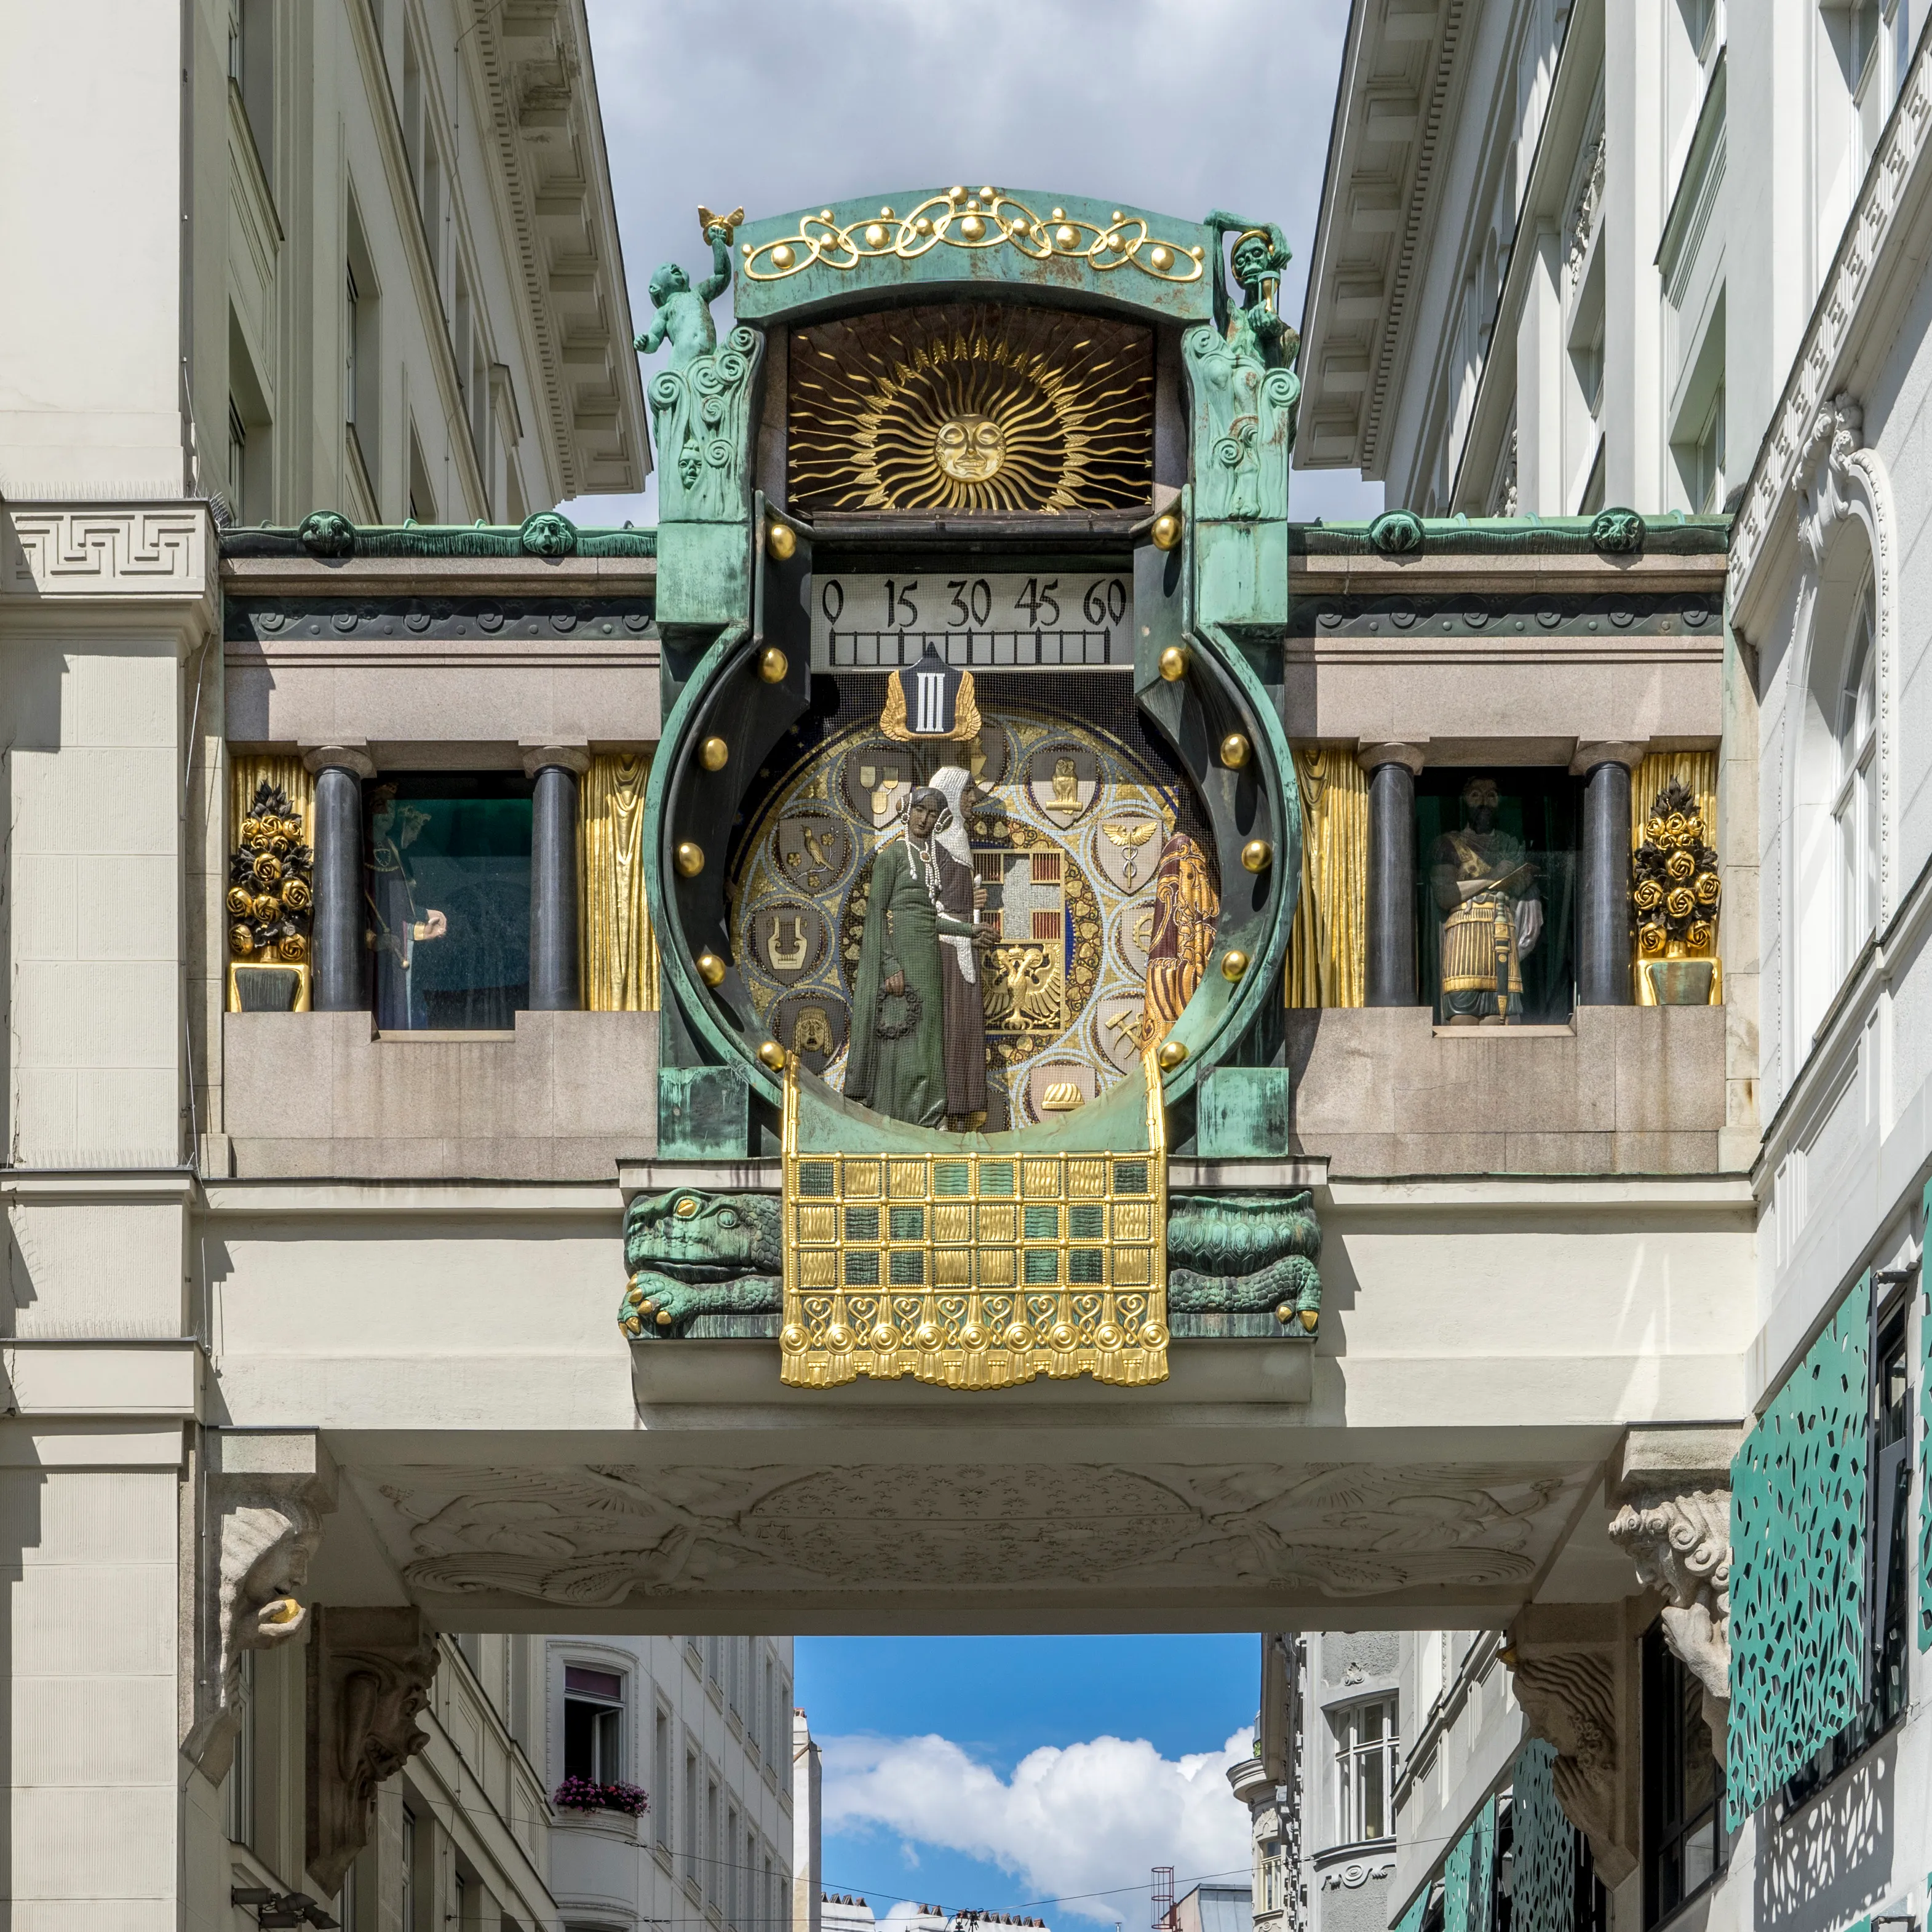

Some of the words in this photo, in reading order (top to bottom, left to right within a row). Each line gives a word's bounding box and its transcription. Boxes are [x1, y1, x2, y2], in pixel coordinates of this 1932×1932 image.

[822, 579, 843, 626] 0
[885, 578, 918, 628] 15
[947, 578, 992, 627] 30
[1014, 578, 1060, 628] 45
[1083, 578, 1126, 626] 60
[916, 672, 945, 732] III
